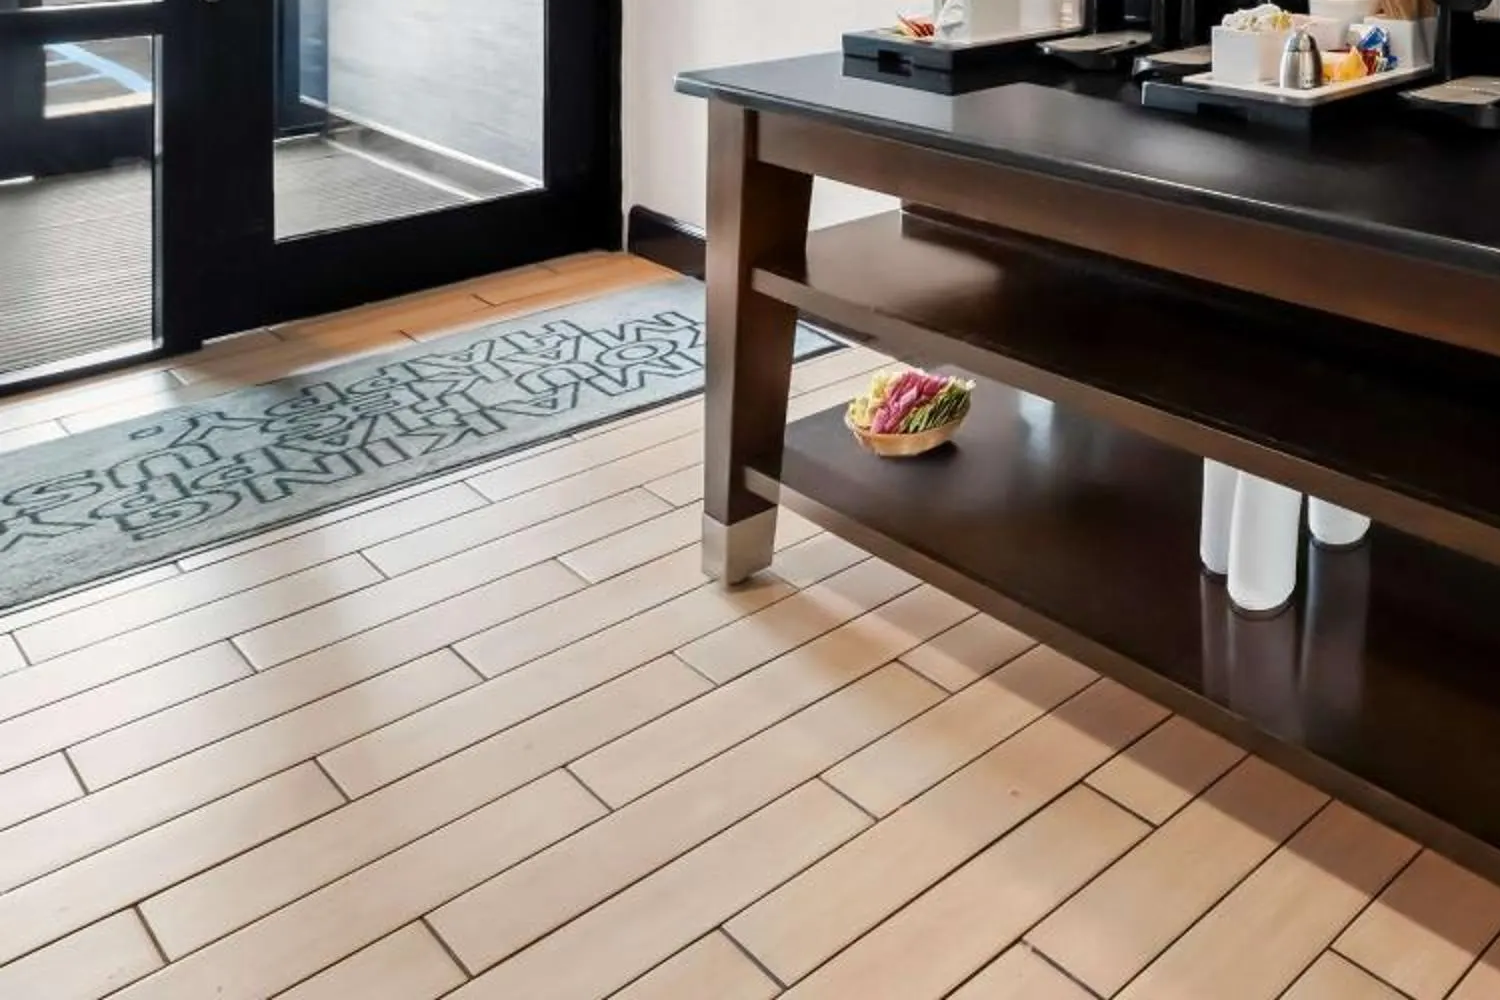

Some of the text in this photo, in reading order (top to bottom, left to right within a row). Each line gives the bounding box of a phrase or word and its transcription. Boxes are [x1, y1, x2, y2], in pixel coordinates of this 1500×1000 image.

[0, 391, 482, 552] HAPPY
[3, 312, 703, 517] MAKES US
[116, 351, 704, 541] MAKING
